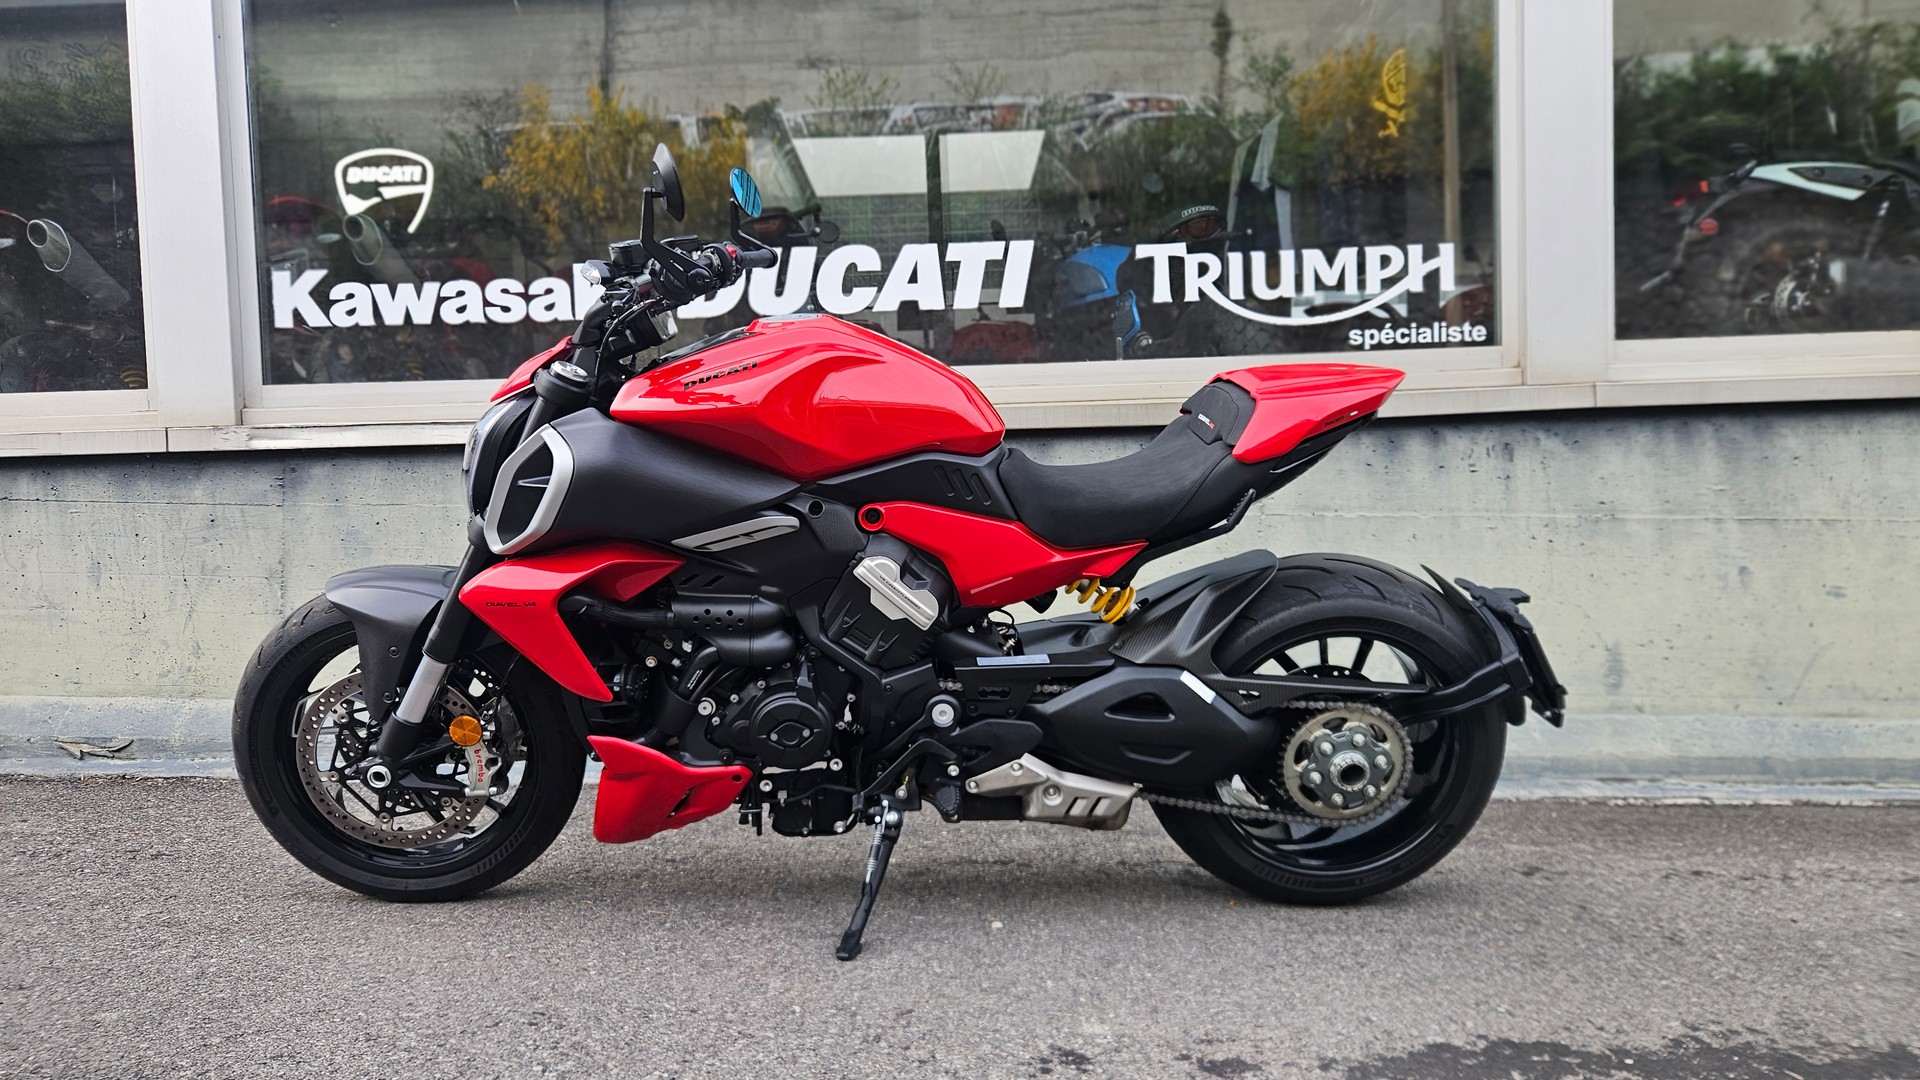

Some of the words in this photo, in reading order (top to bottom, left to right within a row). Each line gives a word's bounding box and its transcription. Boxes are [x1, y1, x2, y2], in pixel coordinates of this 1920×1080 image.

[346, 164, 422, 184] DUCATI
[271, 262, 606, 329] Kawasak
[1134, 242, 1456, 326] TRIUMPH
[1348, 322, 1487, 350] spécialiste
[683, 360, 758, 391] DUCATI
[474, 748, 486, 783] brembo
